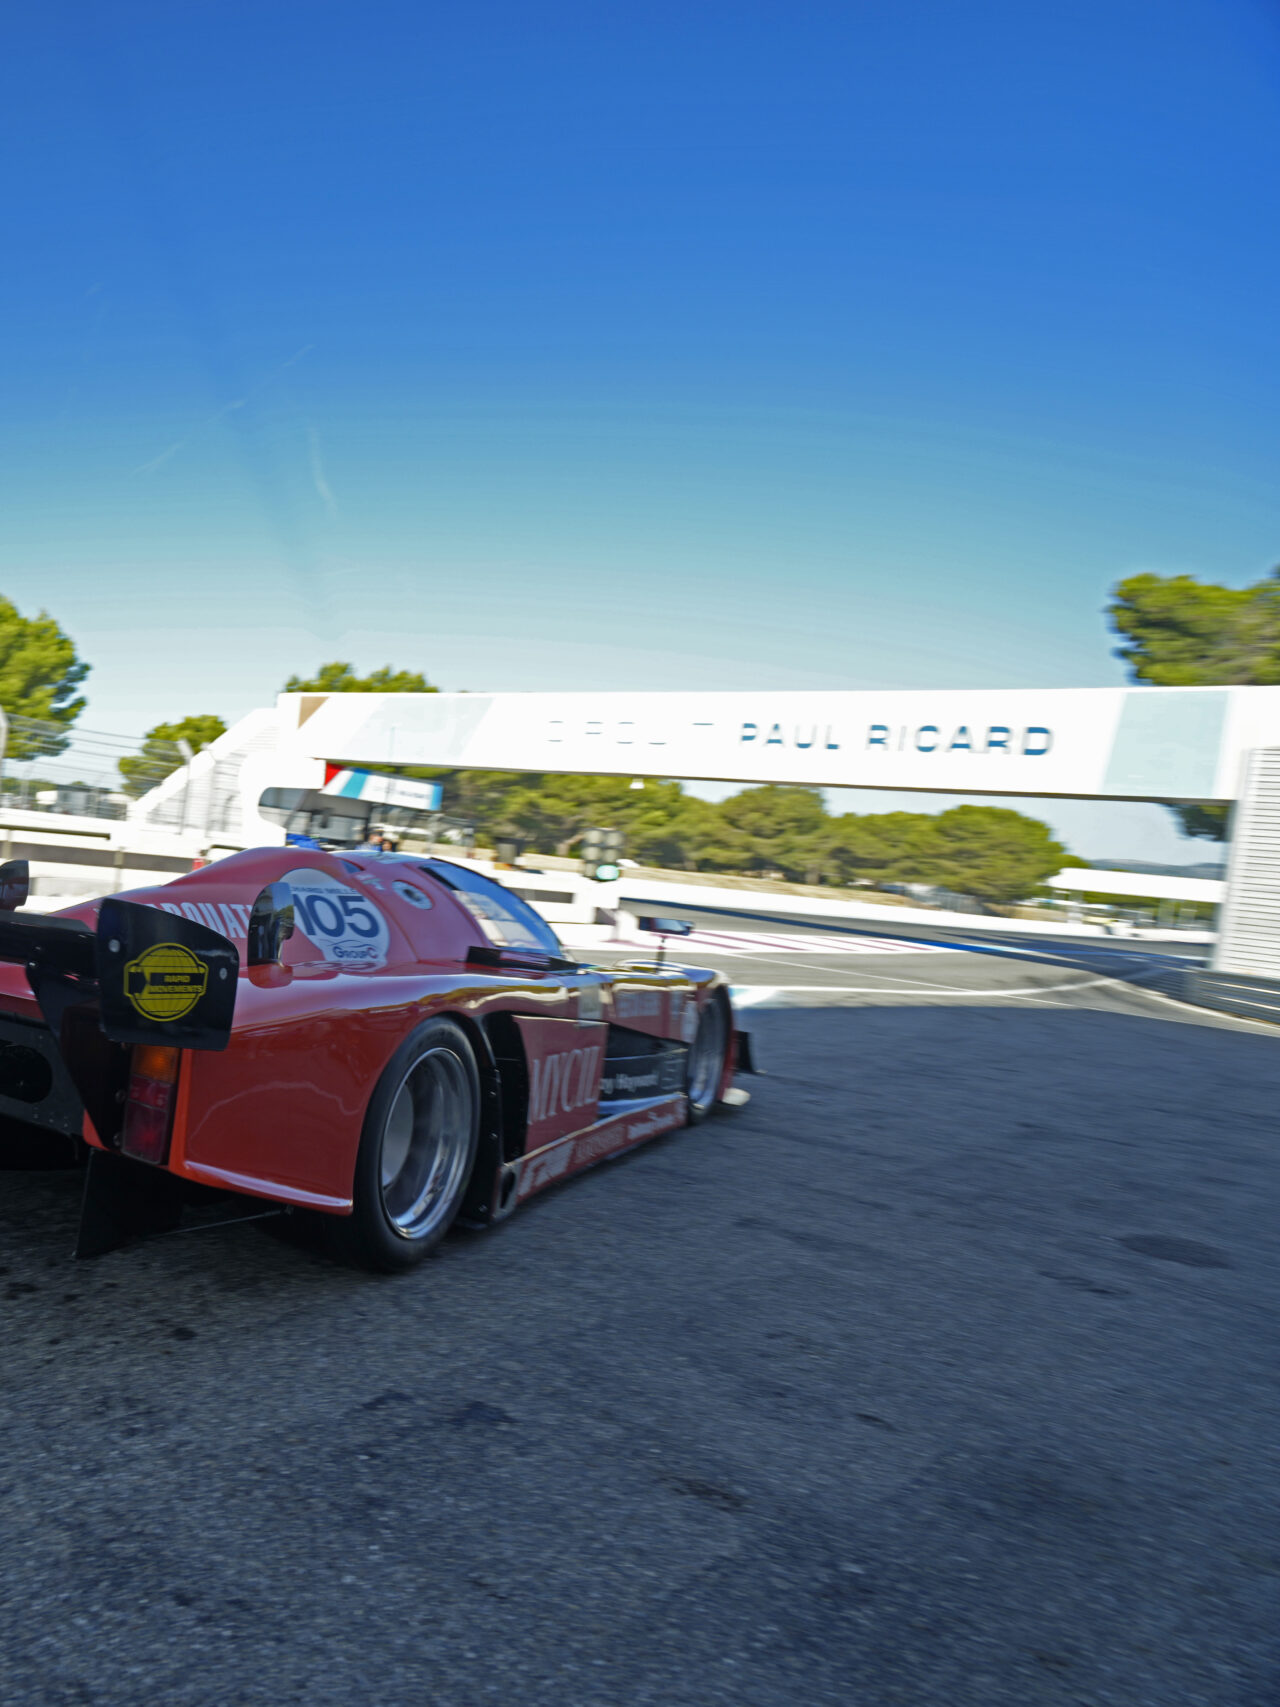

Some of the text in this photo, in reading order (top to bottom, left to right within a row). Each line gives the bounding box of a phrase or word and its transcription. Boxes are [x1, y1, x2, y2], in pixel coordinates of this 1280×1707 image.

[740, 722, 840, 750] PAUL
[865, 725, 1054, 756] RICARD
[293, 893, 380, 938] 105
